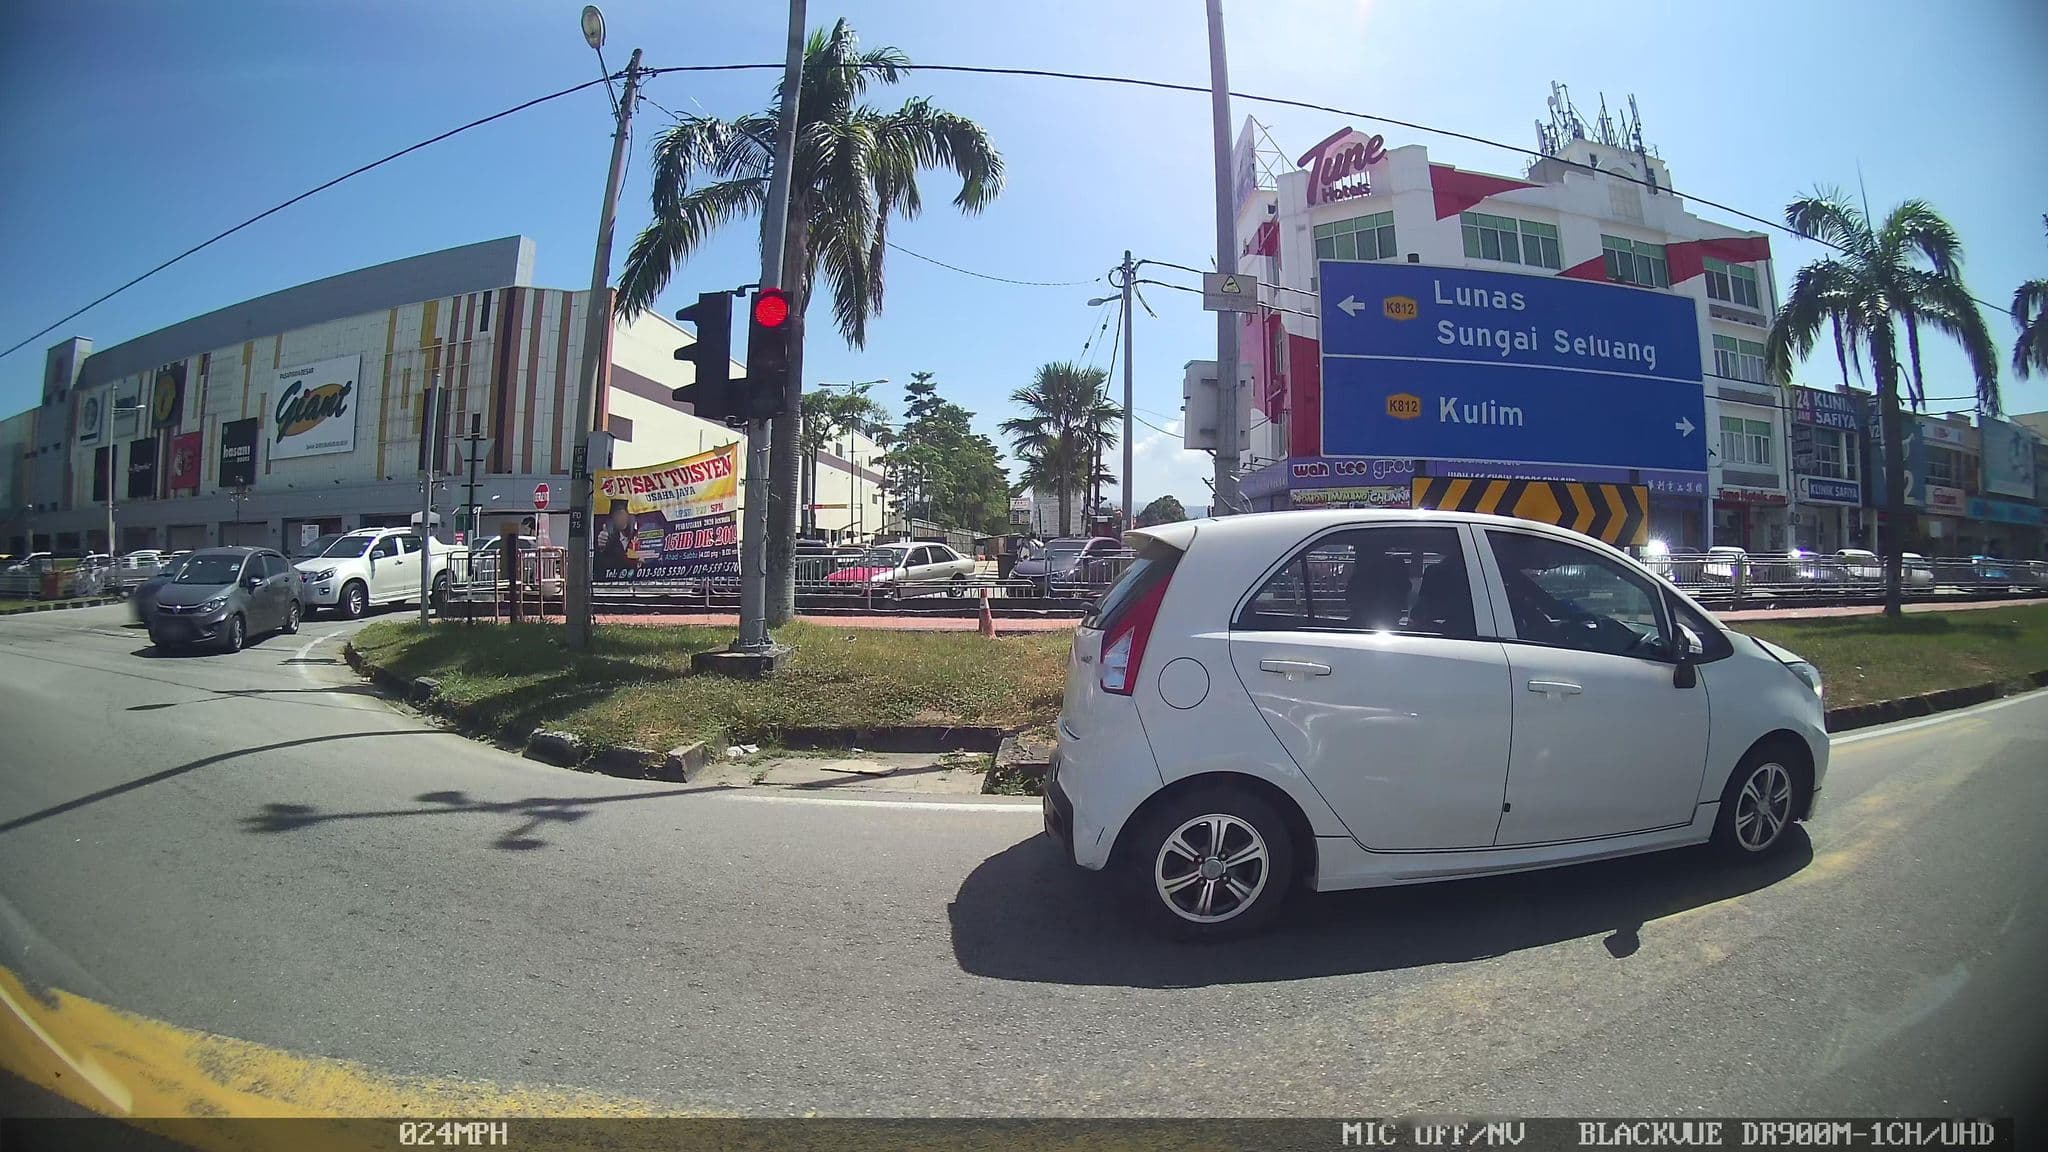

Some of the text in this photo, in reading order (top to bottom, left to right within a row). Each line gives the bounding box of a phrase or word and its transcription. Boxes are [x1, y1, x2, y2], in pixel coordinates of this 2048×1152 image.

[1297, 126, 1387, 206] Tune
[1322, 182, 1371, 204] Hotels
[1434, 279, 1526, 311] Lunas
[1386, 302, 1415, 315] K812
[1437, 319, 1656, 371] Sungai Seluang
[276, 380, 353, 444] Giant
[1389, 399, 1418, 413] K812
[1439, 396, 1523, 426] Kulim
[1796, 390, 1810, 411] 24
[1813, 391, 1855, 413] KLINI
[1815, 409, 1857, 430] SAFIYA
[617, 454, 732, 494] PUSAT TUISYEN
[645, 486, 696, 502] USAHA JAYA
[1810, 483, 1857, 499] KLINIK SAFIYA
[664, 531, 694, 551] 15HB
